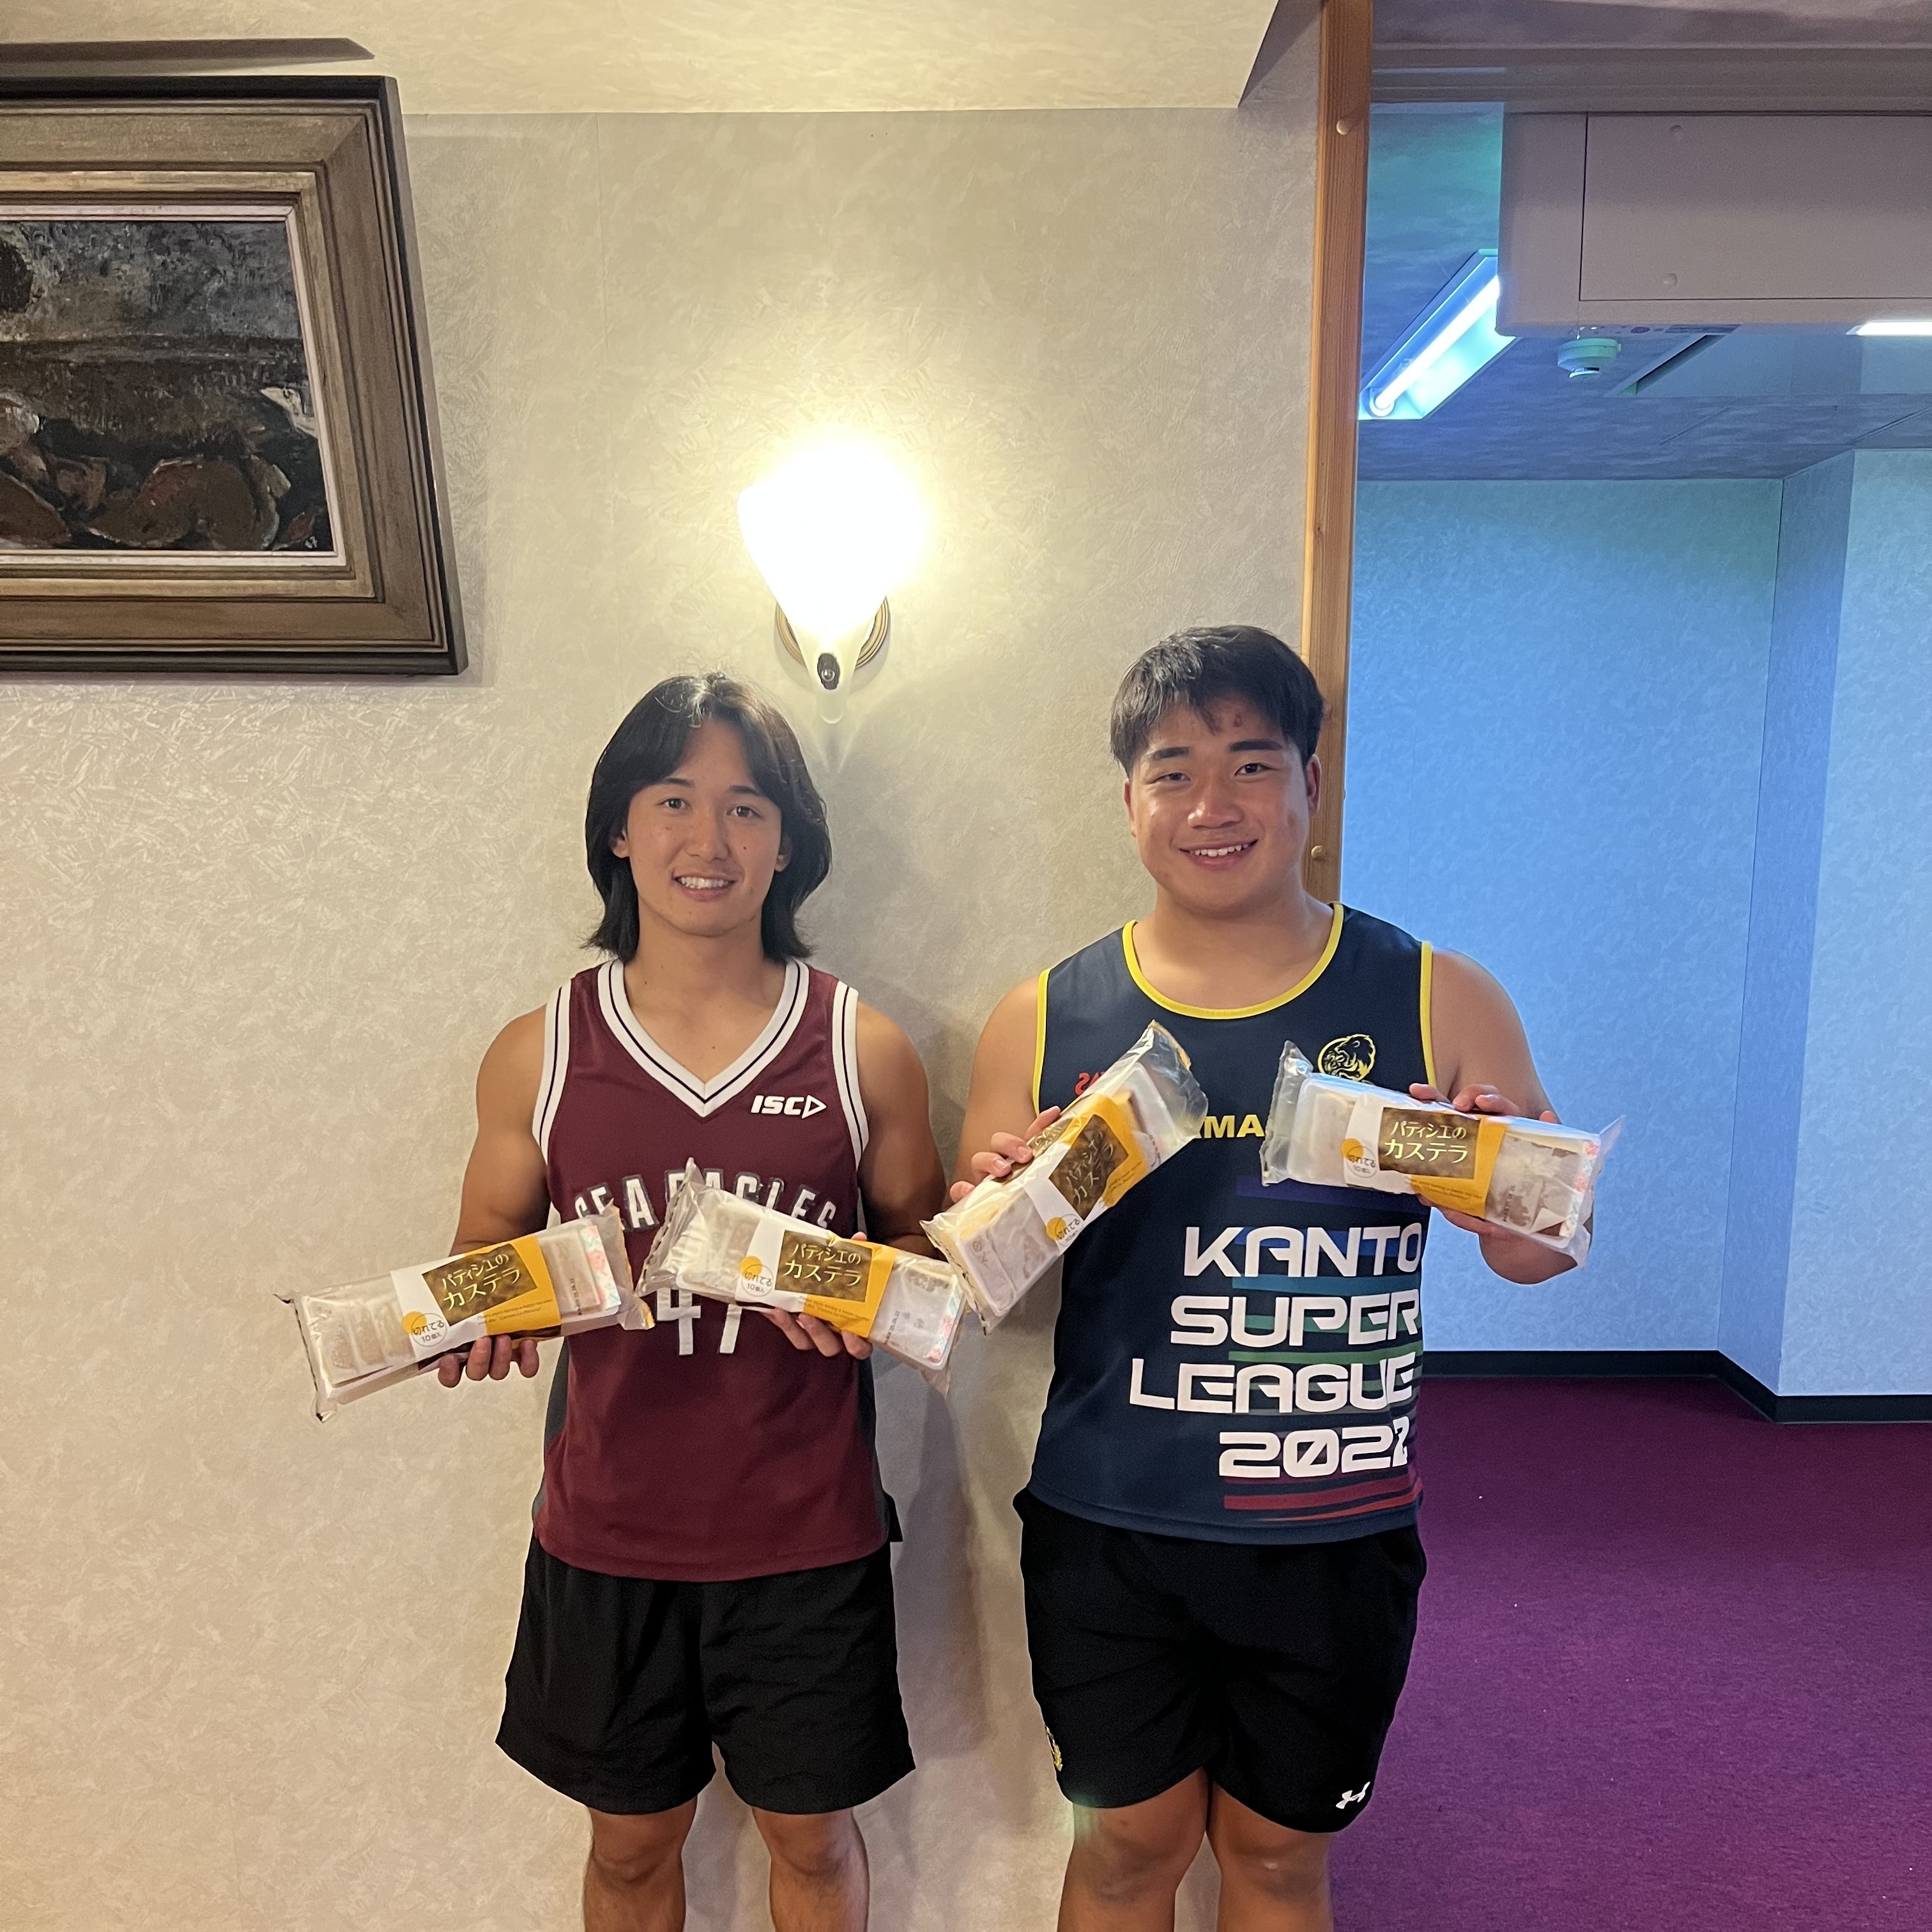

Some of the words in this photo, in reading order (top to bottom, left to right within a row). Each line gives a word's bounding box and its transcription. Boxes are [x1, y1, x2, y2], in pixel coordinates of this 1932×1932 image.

[751, 1094, 804, 1116] ISC
[1390, 1120, 1468, 1140] パティシエの
[1384, 1138, 1468, 1164] カステラ
[792, 1243, 861, 1265] パティシエの
[1184, 1223, 1422, 1277] KANTO
[783, 1259, 861, 1287] カステラ
[443, 1266, 521, 1310] カステラ
[1170, 1289, 1419, 1347] SUPER
[1130, 1352, 1416, 1413] LEAGUE
